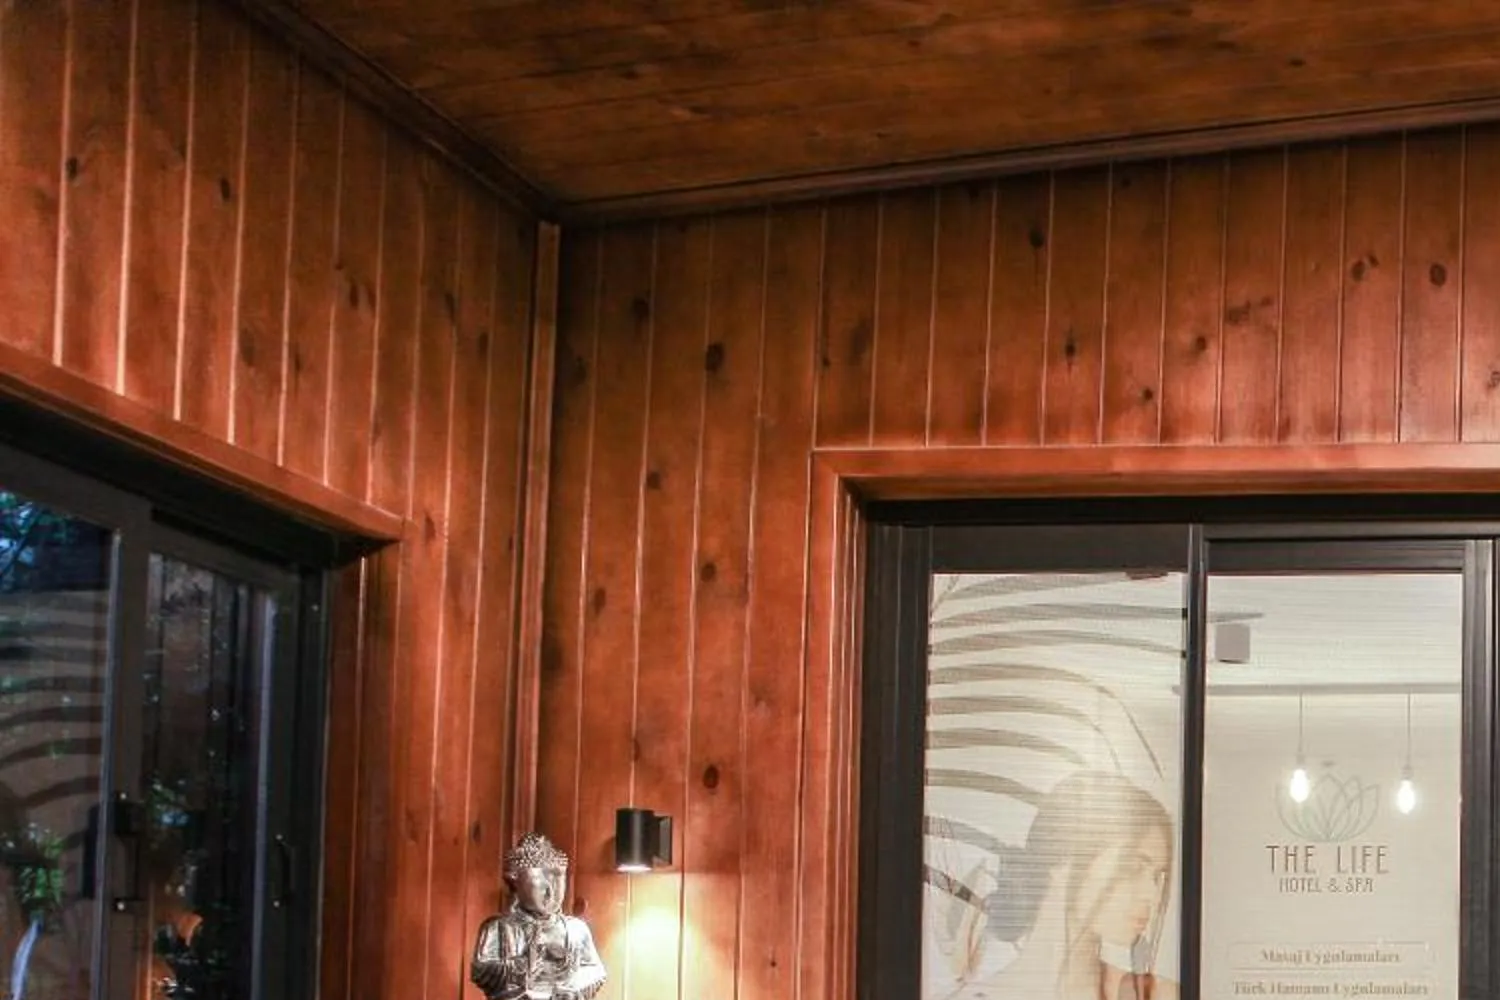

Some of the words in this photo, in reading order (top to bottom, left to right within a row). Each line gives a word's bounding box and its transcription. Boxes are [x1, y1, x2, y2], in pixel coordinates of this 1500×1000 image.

[1266, 845, 1316, 874] THE
[1337, 845, 1389, 874] LIFE
[1279, 877, 1322, 893] HOTEL
[1328, 877, 1342, 893] &
[1345, 877, 1374, 893] SPA
